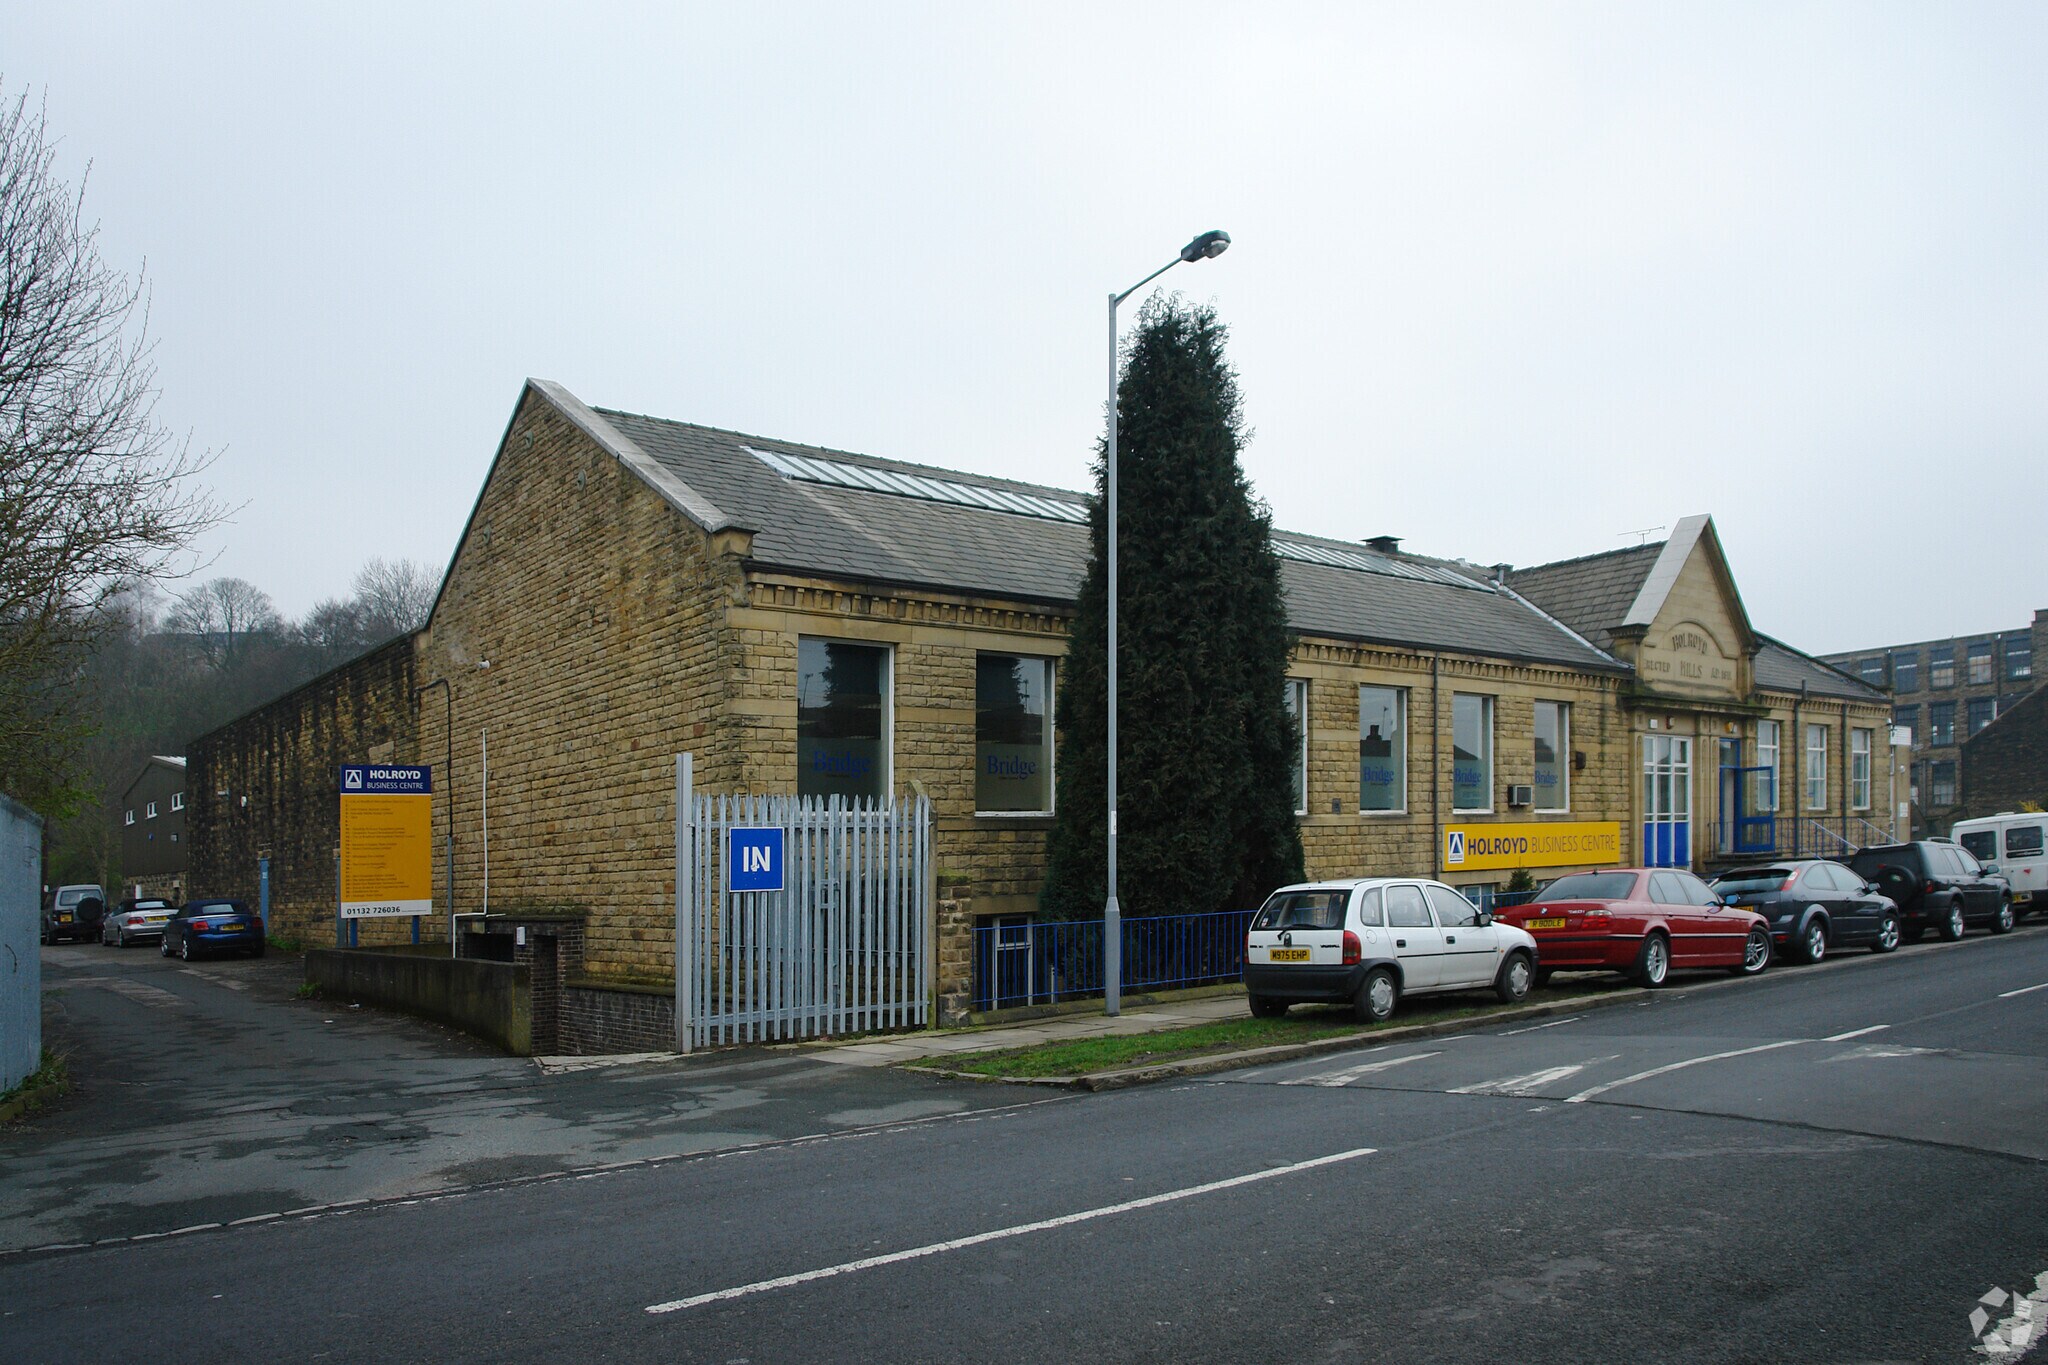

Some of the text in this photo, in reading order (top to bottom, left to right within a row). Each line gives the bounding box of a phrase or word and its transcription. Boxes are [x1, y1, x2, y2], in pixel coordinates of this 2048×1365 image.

[369, 769, 421, 780] HOLROYD
[813, 751, 871, 779] Bridge
[987, 754, 1036, 780] Bridge
[366, 781, 424, 790] BUSINESS CENTRE
[1363, 766, 1395, 786] Bridge
[1454, 767, 1482, 787] Bridge
[1467, 834, 1616, 855] HOLROYD BUSINESS CENTRE
[743, 846, 770, 872] IN
[346, 907, 371, 915] 01132
[373, 906, 400, 914] 726036
[1291, 949, 1308, 960] EHP
